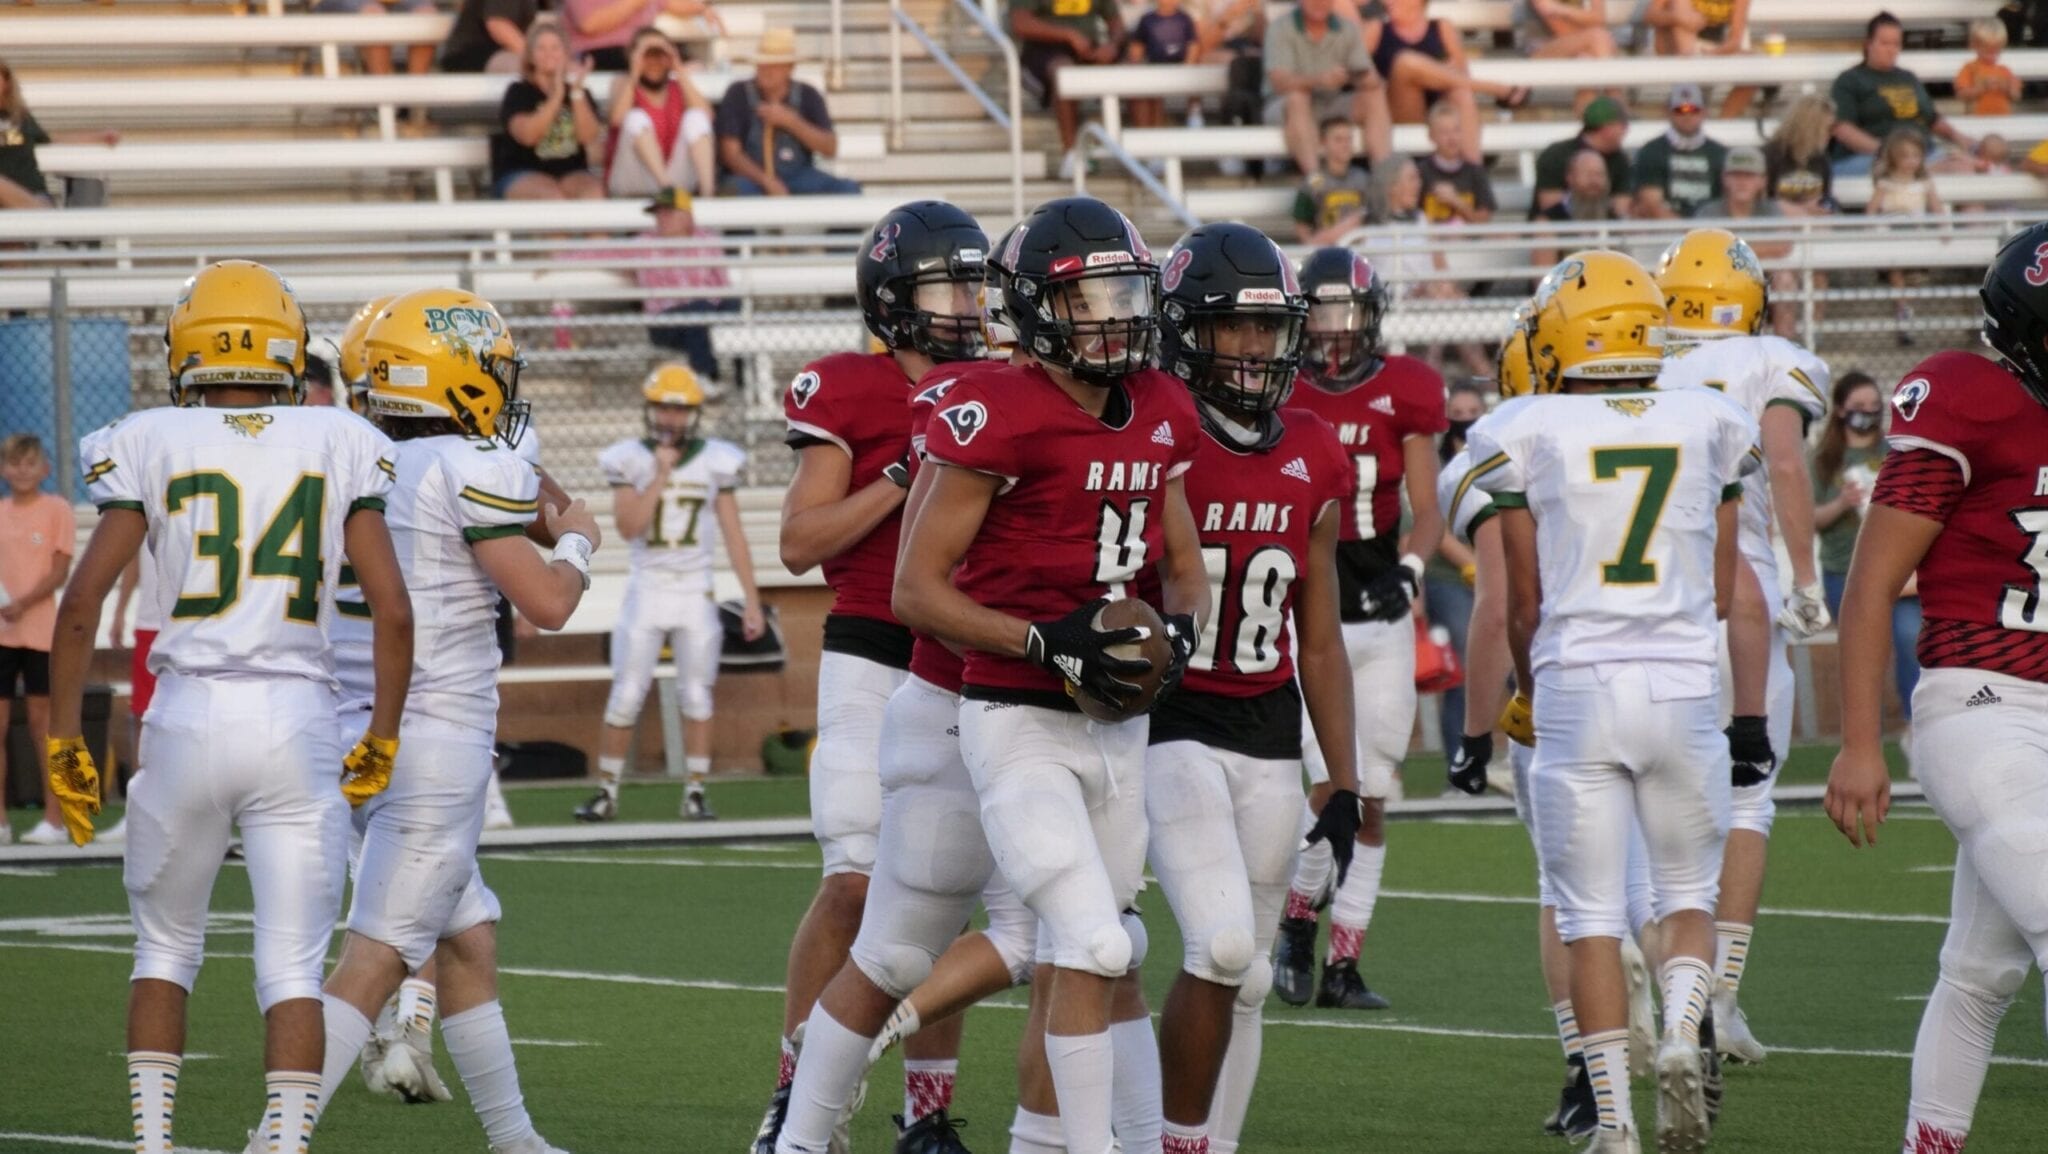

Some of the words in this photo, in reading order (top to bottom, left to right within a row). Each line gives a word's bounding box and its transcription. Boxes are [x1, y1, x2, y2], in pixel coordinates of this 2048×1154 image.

[1092, 252, 1130, 263] Riddell
[1162, 249, 1193, 292] 8
[1244, 291, 1281, 301] Riddell
[424, 307, 502, 338] BOYD
[191, 371, 237, 383] YELLOW
[238, 370, 285, 382] JACKETS
[378, 360, 389, 382] 9
[1581, 365, 1625, 375] YELLOW
[380, 399, 424, 414] JACKETS
[1085, 461, 1163, 492] RAMS
[645, 496, 706, 548] 17
[1202, 501, 1294, 533] RAMS
[1588, 443, 1682, 587] 7
[164, 468, 328, 627] 34
[1094, 497, 1151, 602] 4
[1966, 695, 2002, 707] adidas
